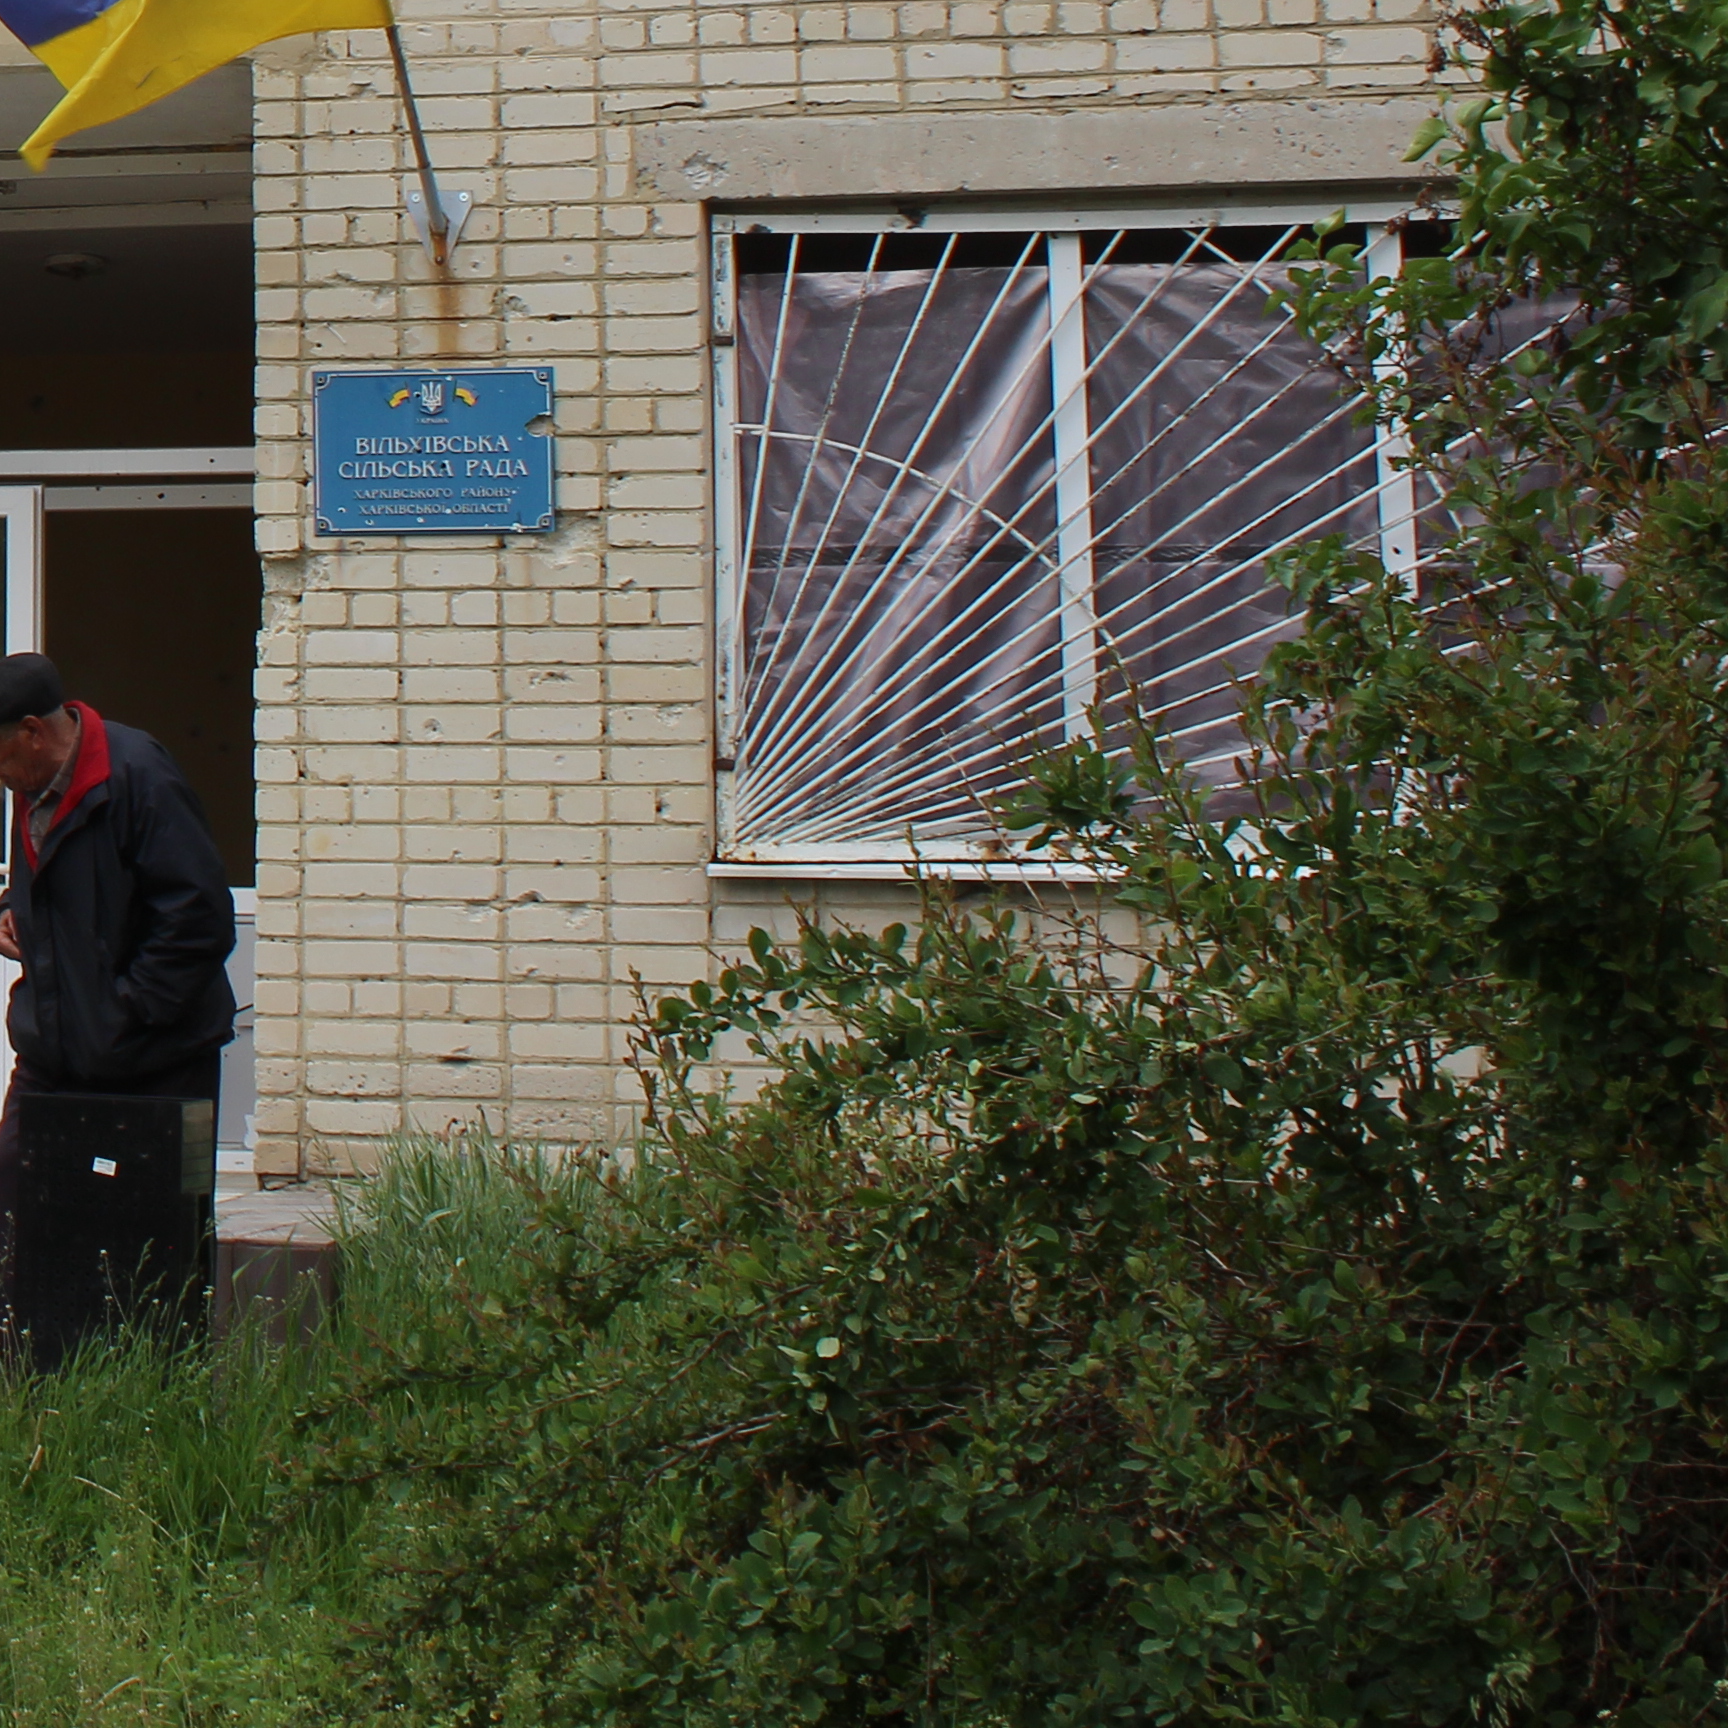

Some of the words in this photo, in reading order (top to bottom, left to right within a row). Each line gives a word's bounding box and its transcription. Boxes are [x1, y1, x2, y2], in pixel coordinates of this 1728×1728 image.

[355, 435, 511, 455] ВІЛЬХІВСЬКА
[338, 460, 455, 479] СІЛЬСЬКА
[465, 459, 529, 479] РАДА
[353, 487, 454, 500] ХАРКІВСЬКОГО
[461, 486, 513, 499] РАЙОНУ
[452, 502, 510, 514] ОБЛАСТІ
